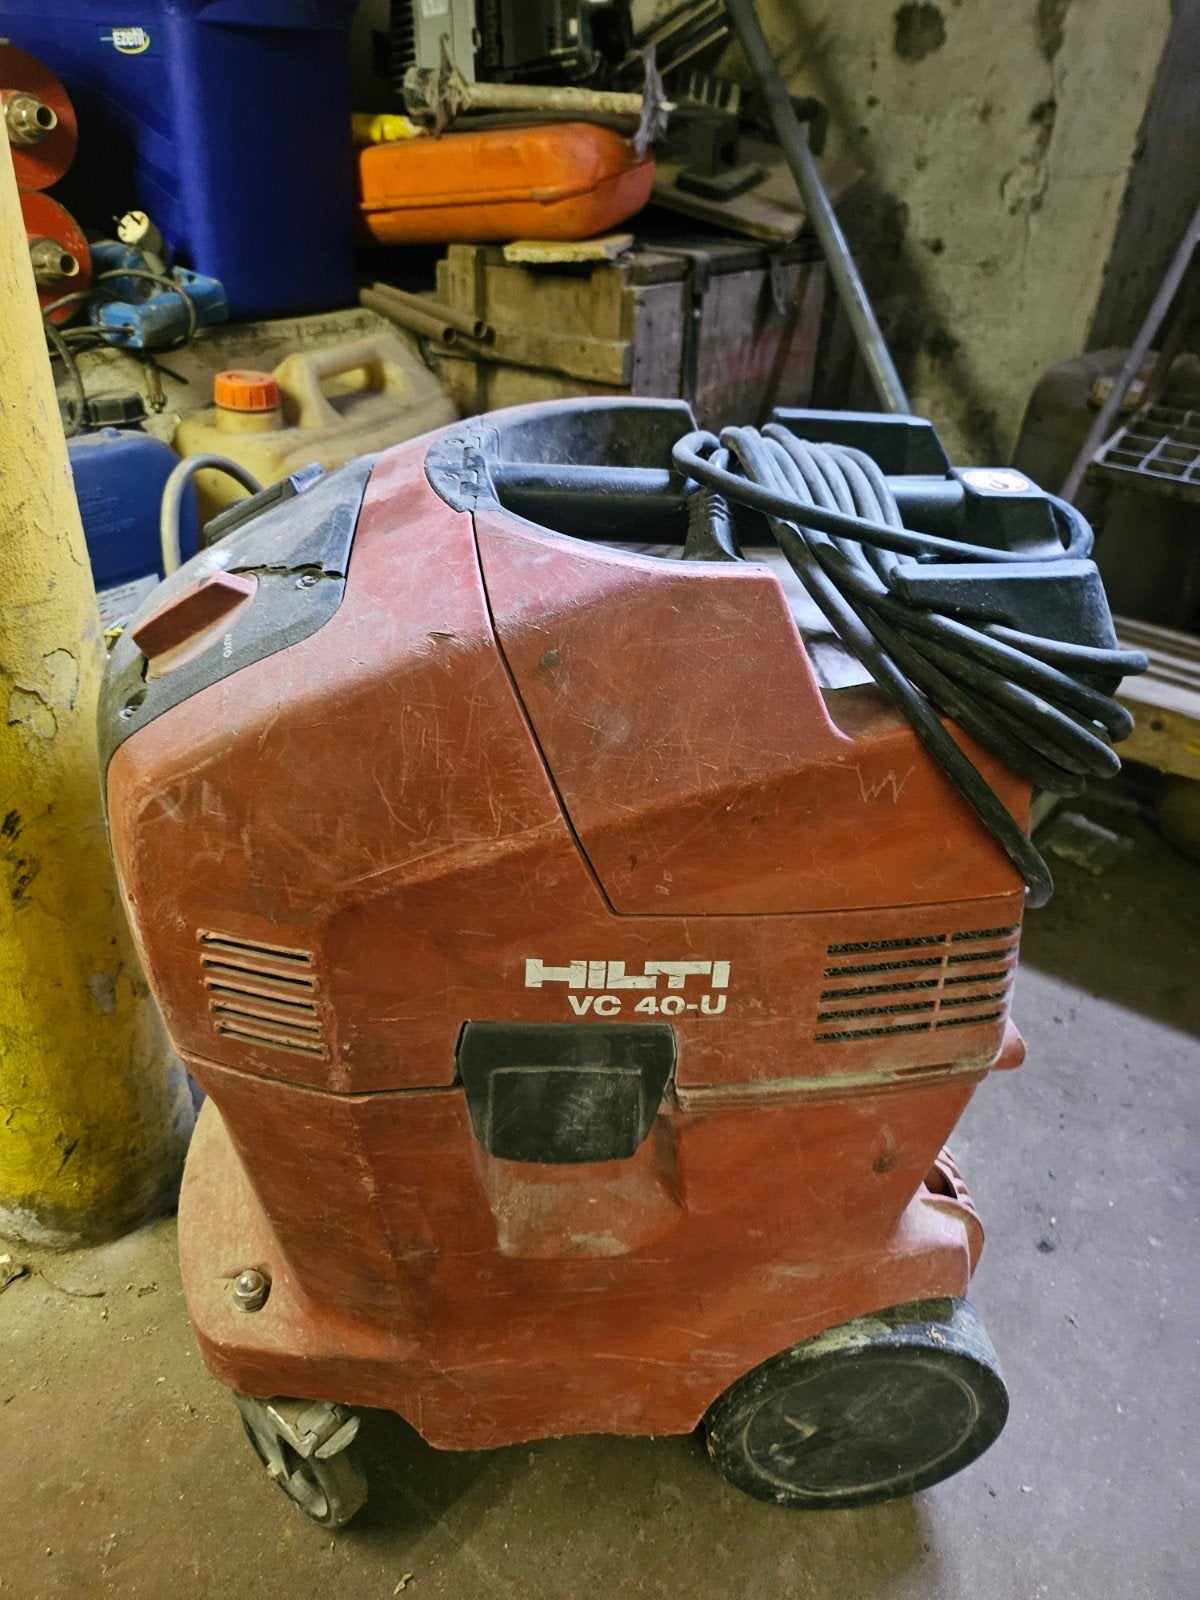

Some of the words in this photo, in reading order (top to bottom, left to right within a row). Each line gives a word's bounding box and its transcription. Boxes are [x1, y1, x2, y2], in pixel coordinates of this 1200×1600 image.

[525, 958, 731, 989] HILTI
[567, 994, 622, 1016] VC
[634, 994, 727, 1016] 40-U
